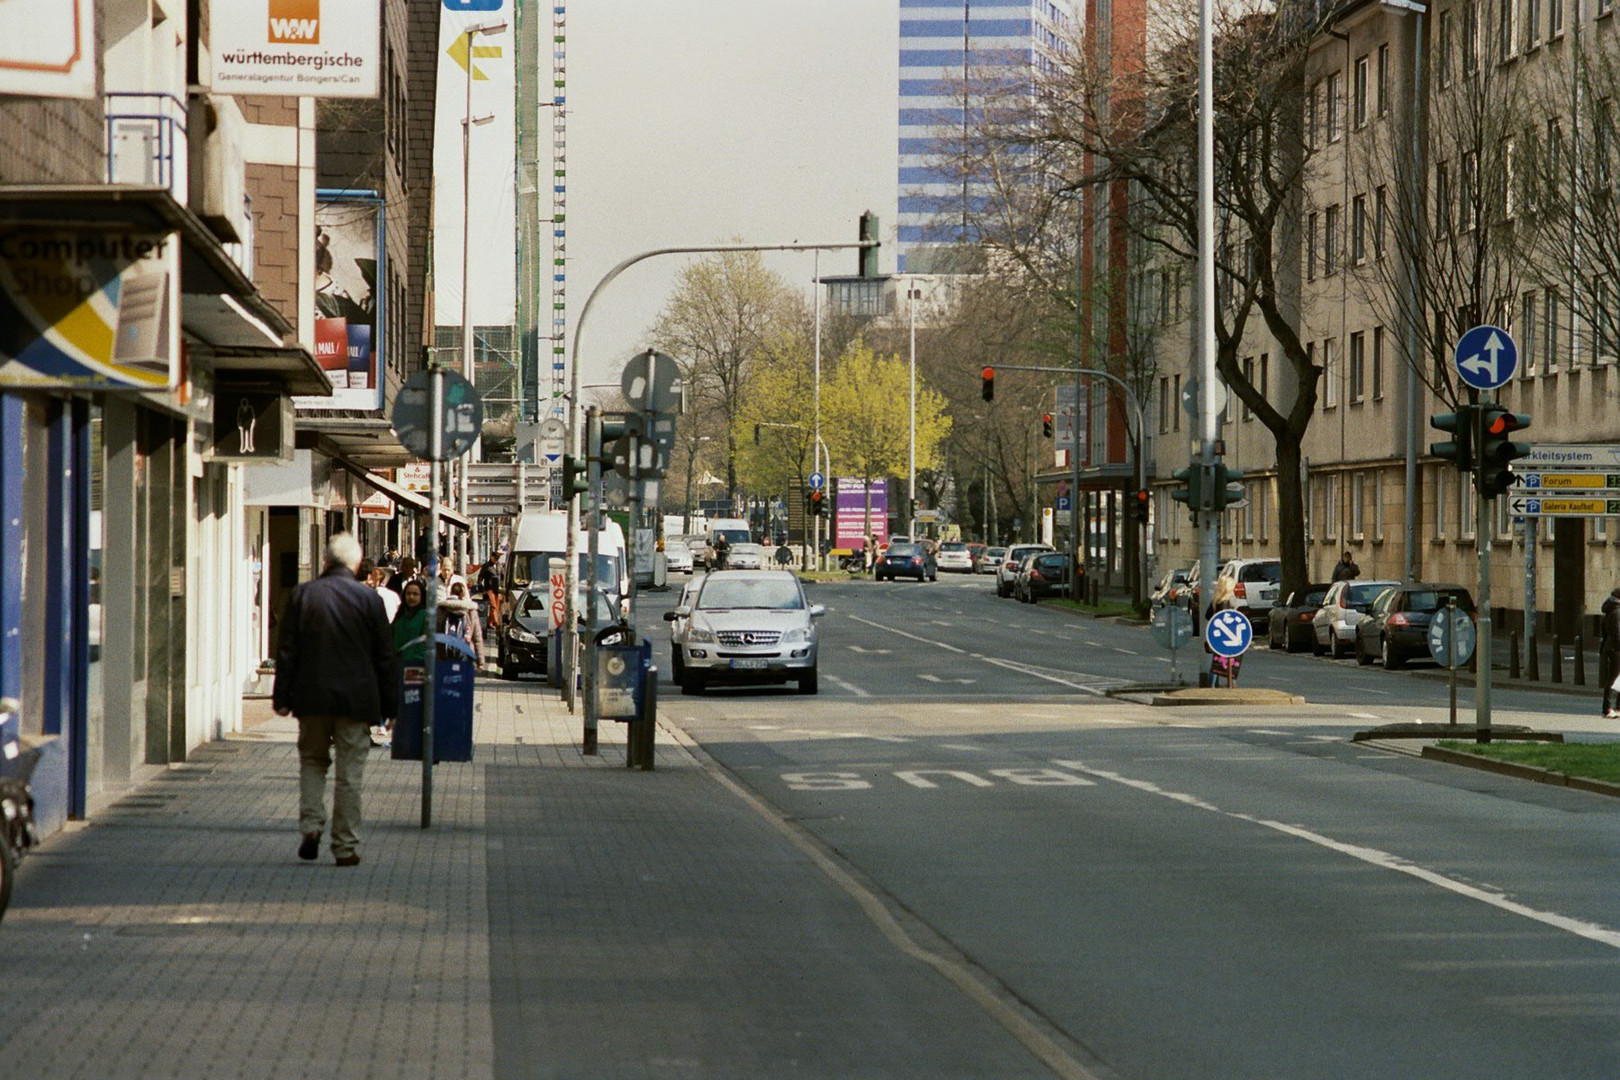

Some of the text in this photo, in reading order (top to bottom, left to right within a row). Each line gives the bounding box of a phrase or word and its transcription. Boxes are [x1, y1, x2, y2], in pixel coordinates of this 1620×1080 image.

[270, 17, 318, 40] W&W
[222, 49, 363, 70] württembergische
[217, 71, 294, 84] Generalagentur
[1543, 476, 1573, 486] Forum
[780, 768, 1099, 791] BUS
